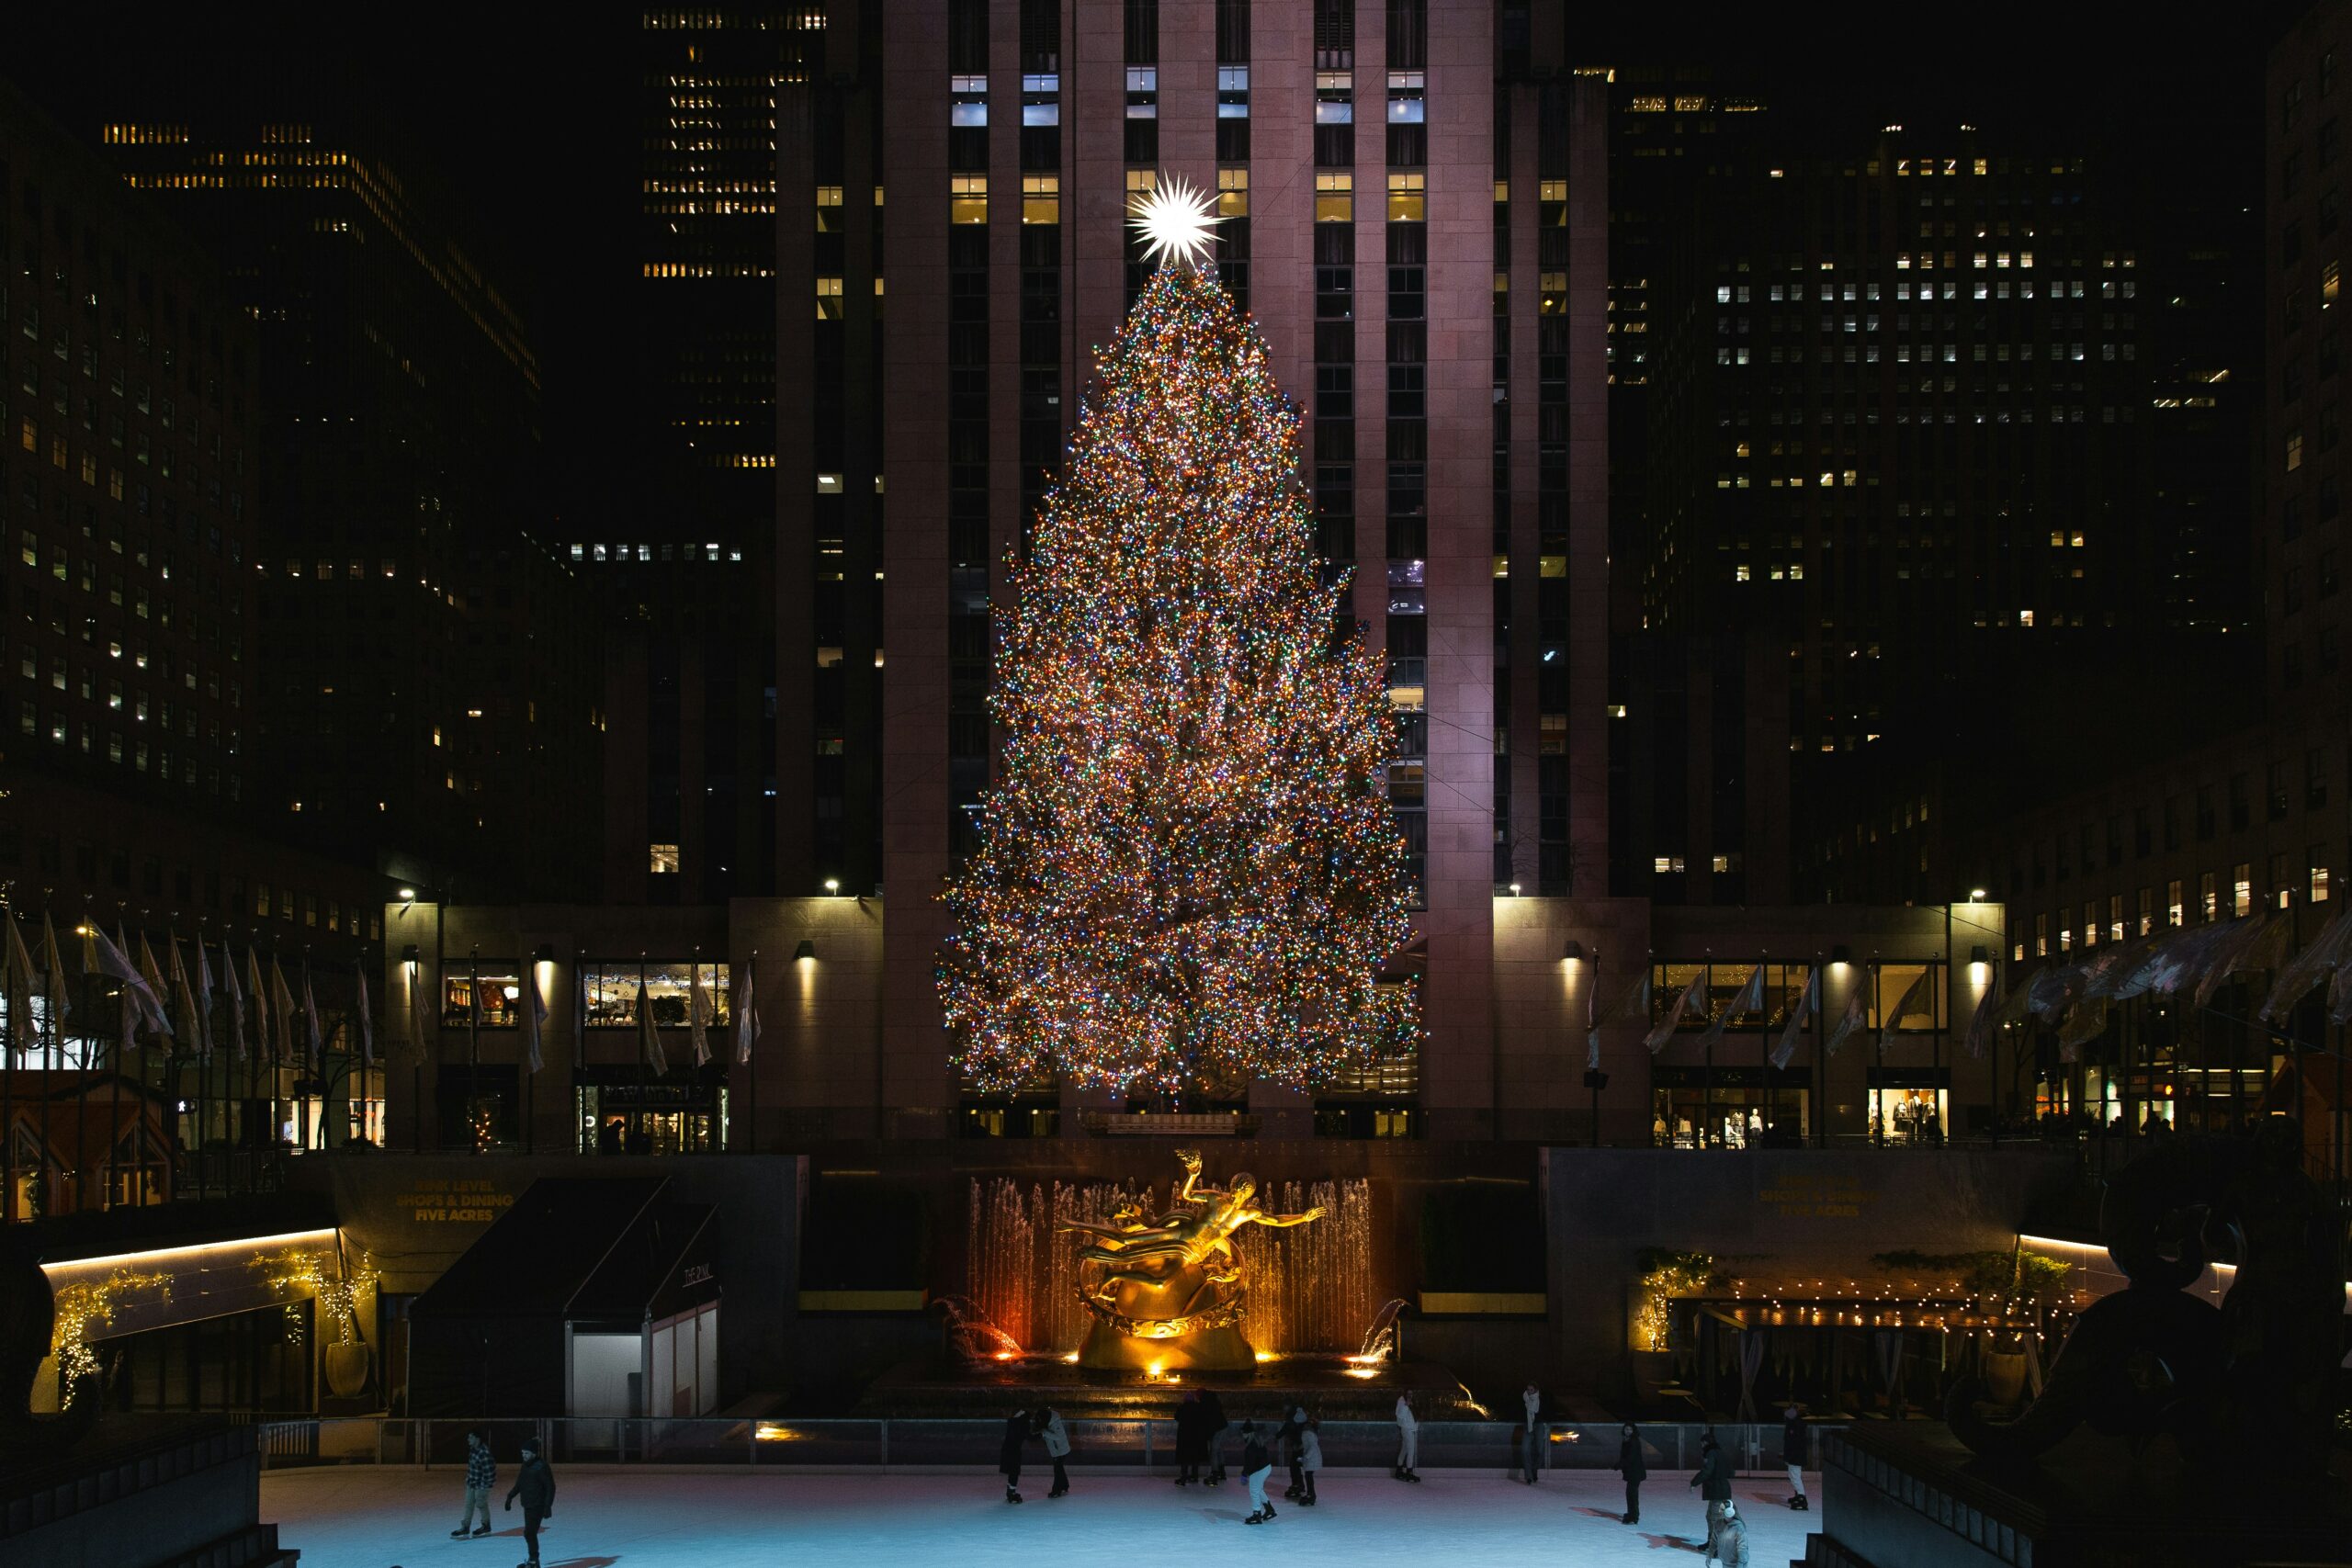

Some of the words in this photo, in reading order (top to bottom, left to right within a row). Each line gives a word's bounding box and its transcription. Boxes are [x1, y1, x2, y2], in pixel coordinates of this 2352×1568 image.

[454, 1179, 494, 1192] LEVEL
[396, 1194, 444, 1207] SHOPS
[447, 1194, 458, 1207] &
[461, 1194, 514, 1207] DINING
[415, 1208, 447, 1222] FIVE
[448, 1208, 493, 1222] ACRES
